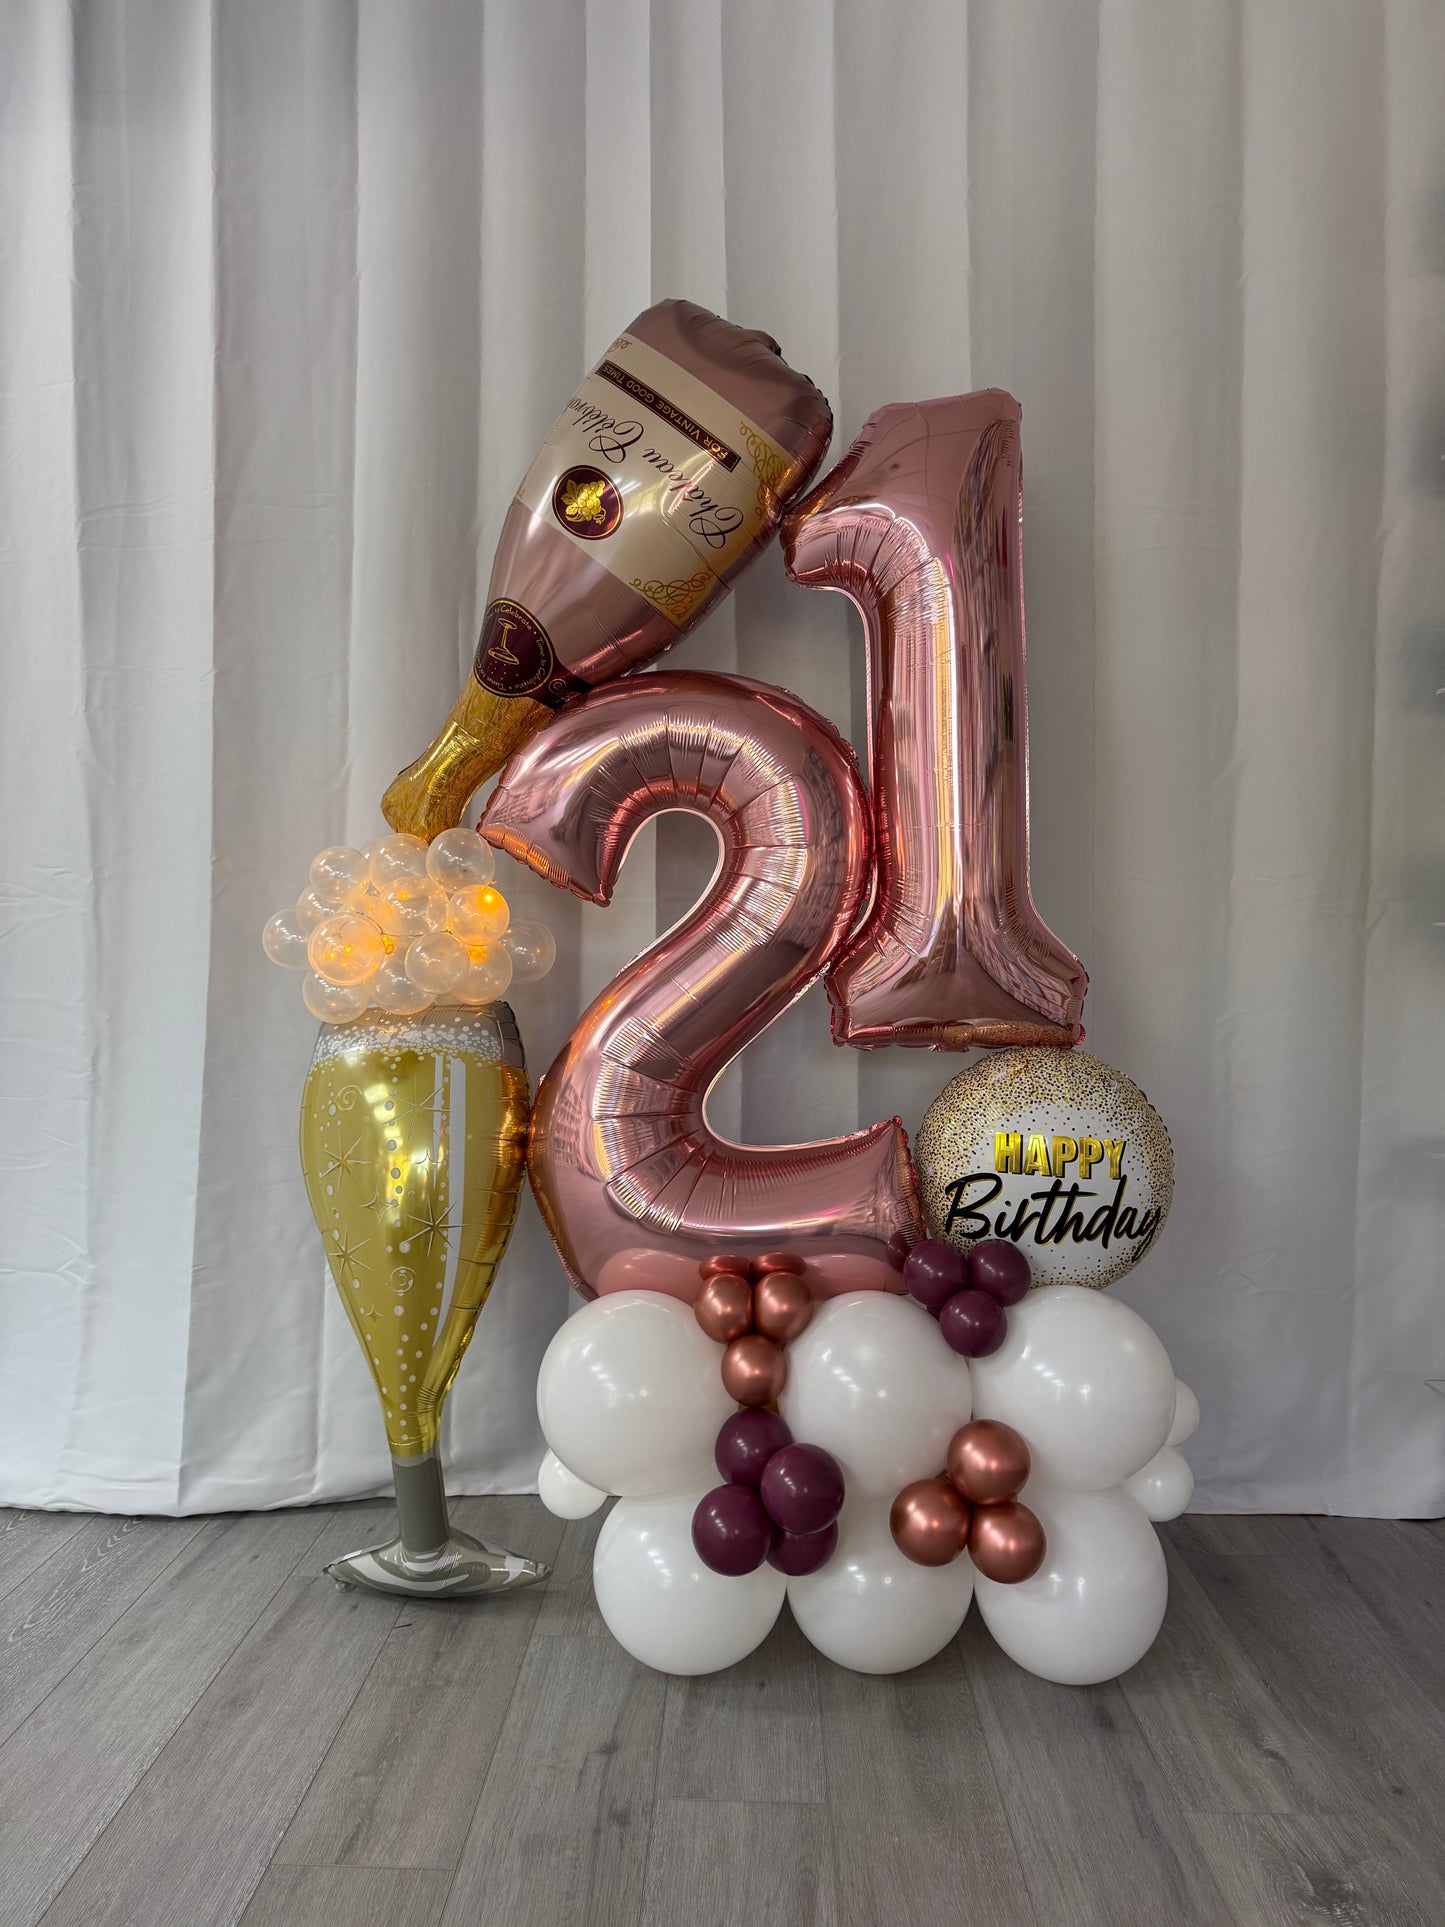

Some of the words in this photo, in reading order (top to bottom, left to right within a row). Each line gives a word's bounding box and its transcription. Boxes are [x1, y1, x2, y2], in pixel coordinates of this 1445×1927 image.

[602, 365, 625, 384] TIMES
[626, 382, 655, 403] GOOD
[655, 400, 700, 440] VINTAGE
[703, 436, 728, 460] FOR
[500, 605, 532, 631] Celebrate
[486, 677, 507, 691] Time
[994, 1132, 1126, 1179] HAPPY
[944, 1172, 1162, 1262] Birthday
